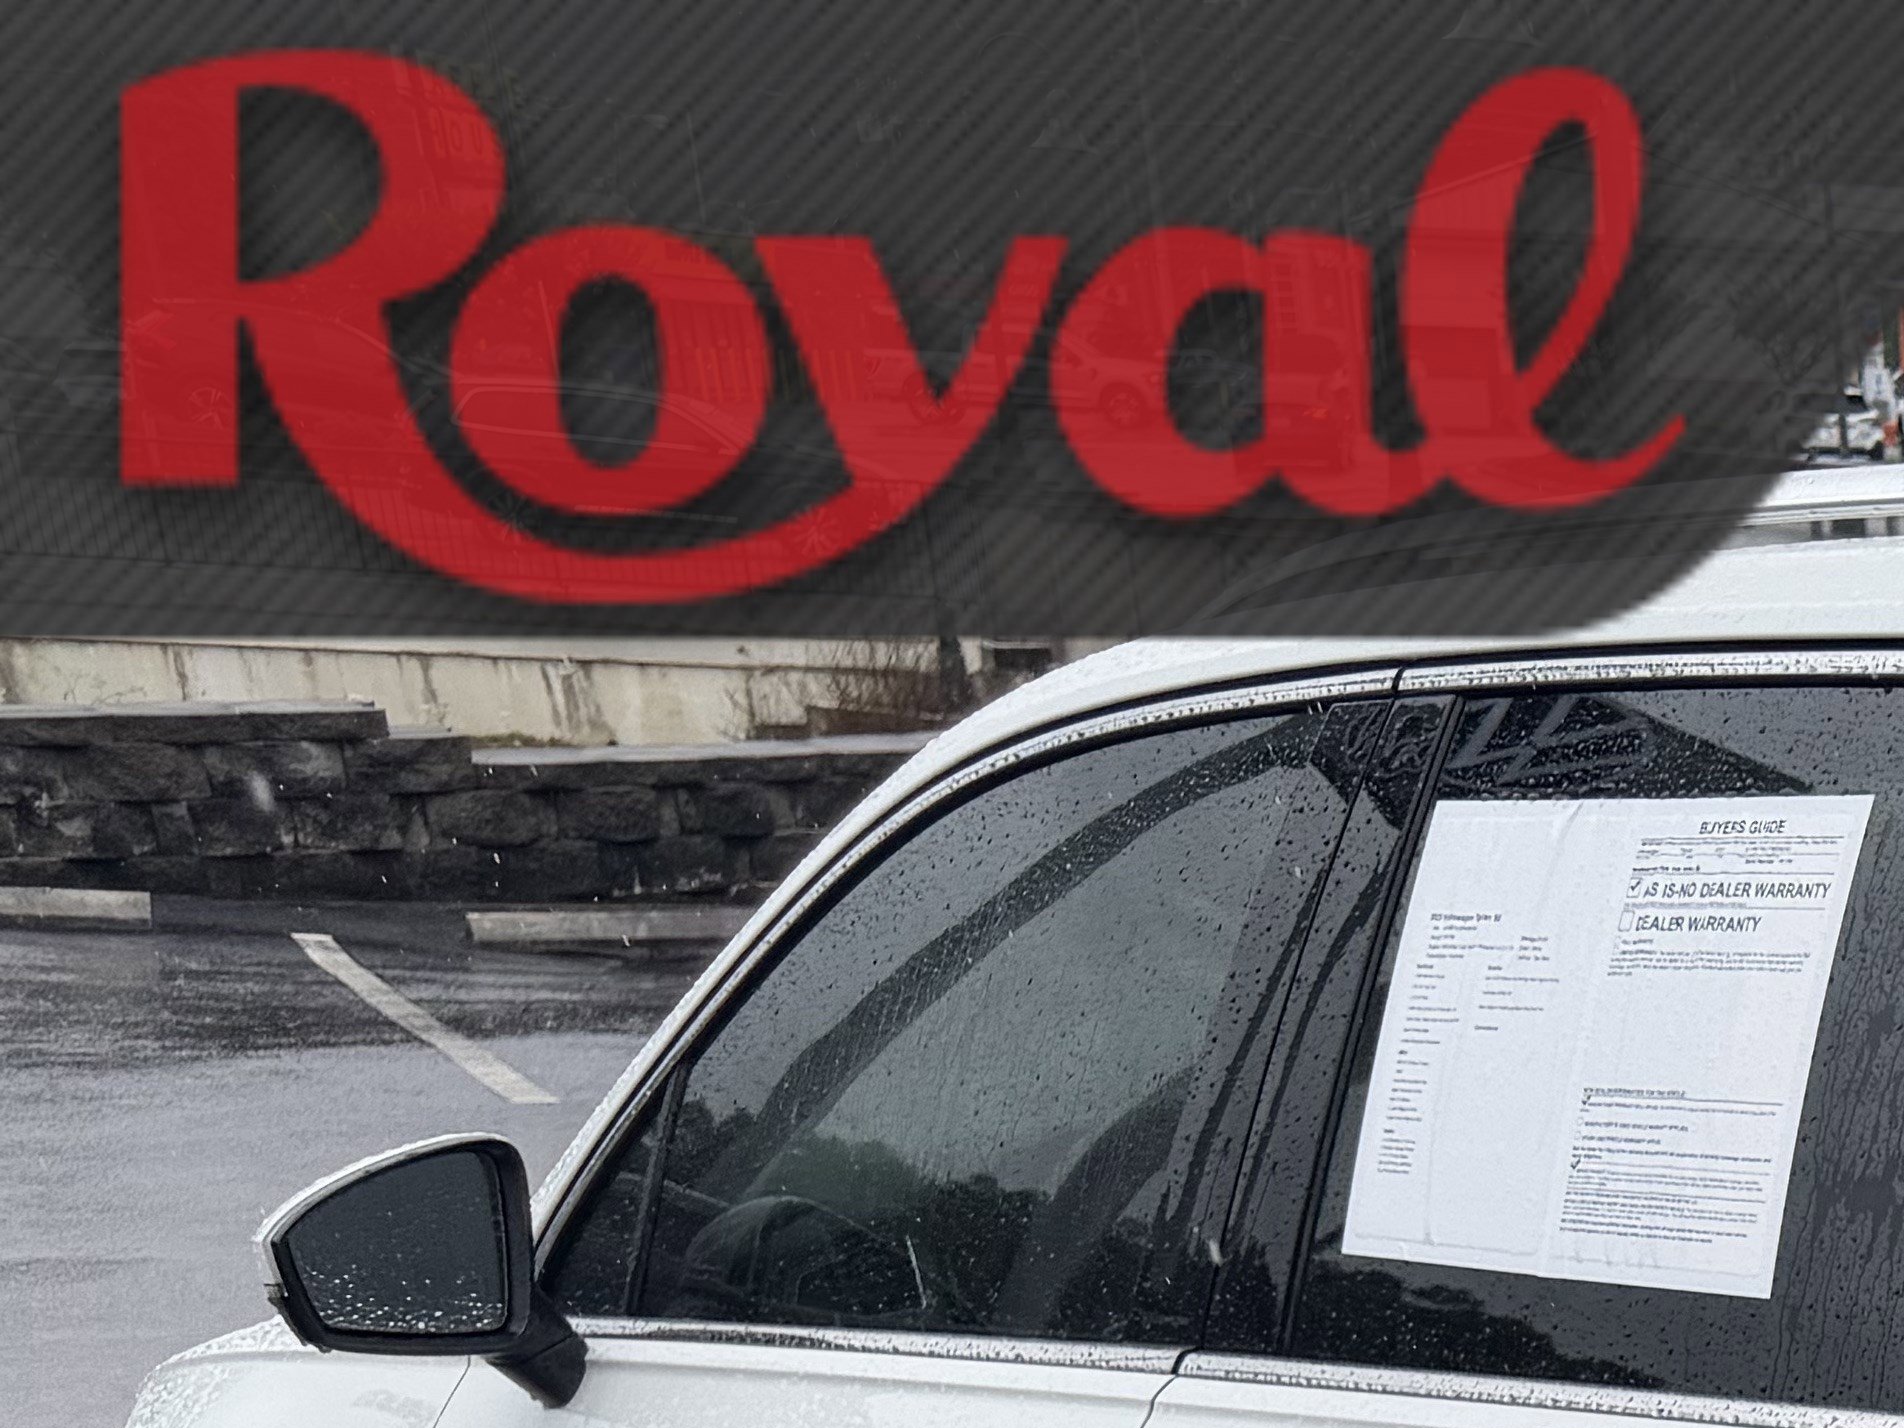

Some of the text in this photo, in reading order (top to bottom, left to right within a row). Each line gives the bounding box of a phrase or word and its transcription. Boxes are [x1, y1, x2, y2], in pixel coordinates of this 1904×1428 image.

[1699, 819, 1787, 835] BUYERS GUIDE
[1642, 881, 1658, 897] AS
[1699, 881, 1751, 898] DEALER
[1754, 882, 1832, 899] WARRANTY
[1635, 915, 1762, 933] DEALER WARRANTY
